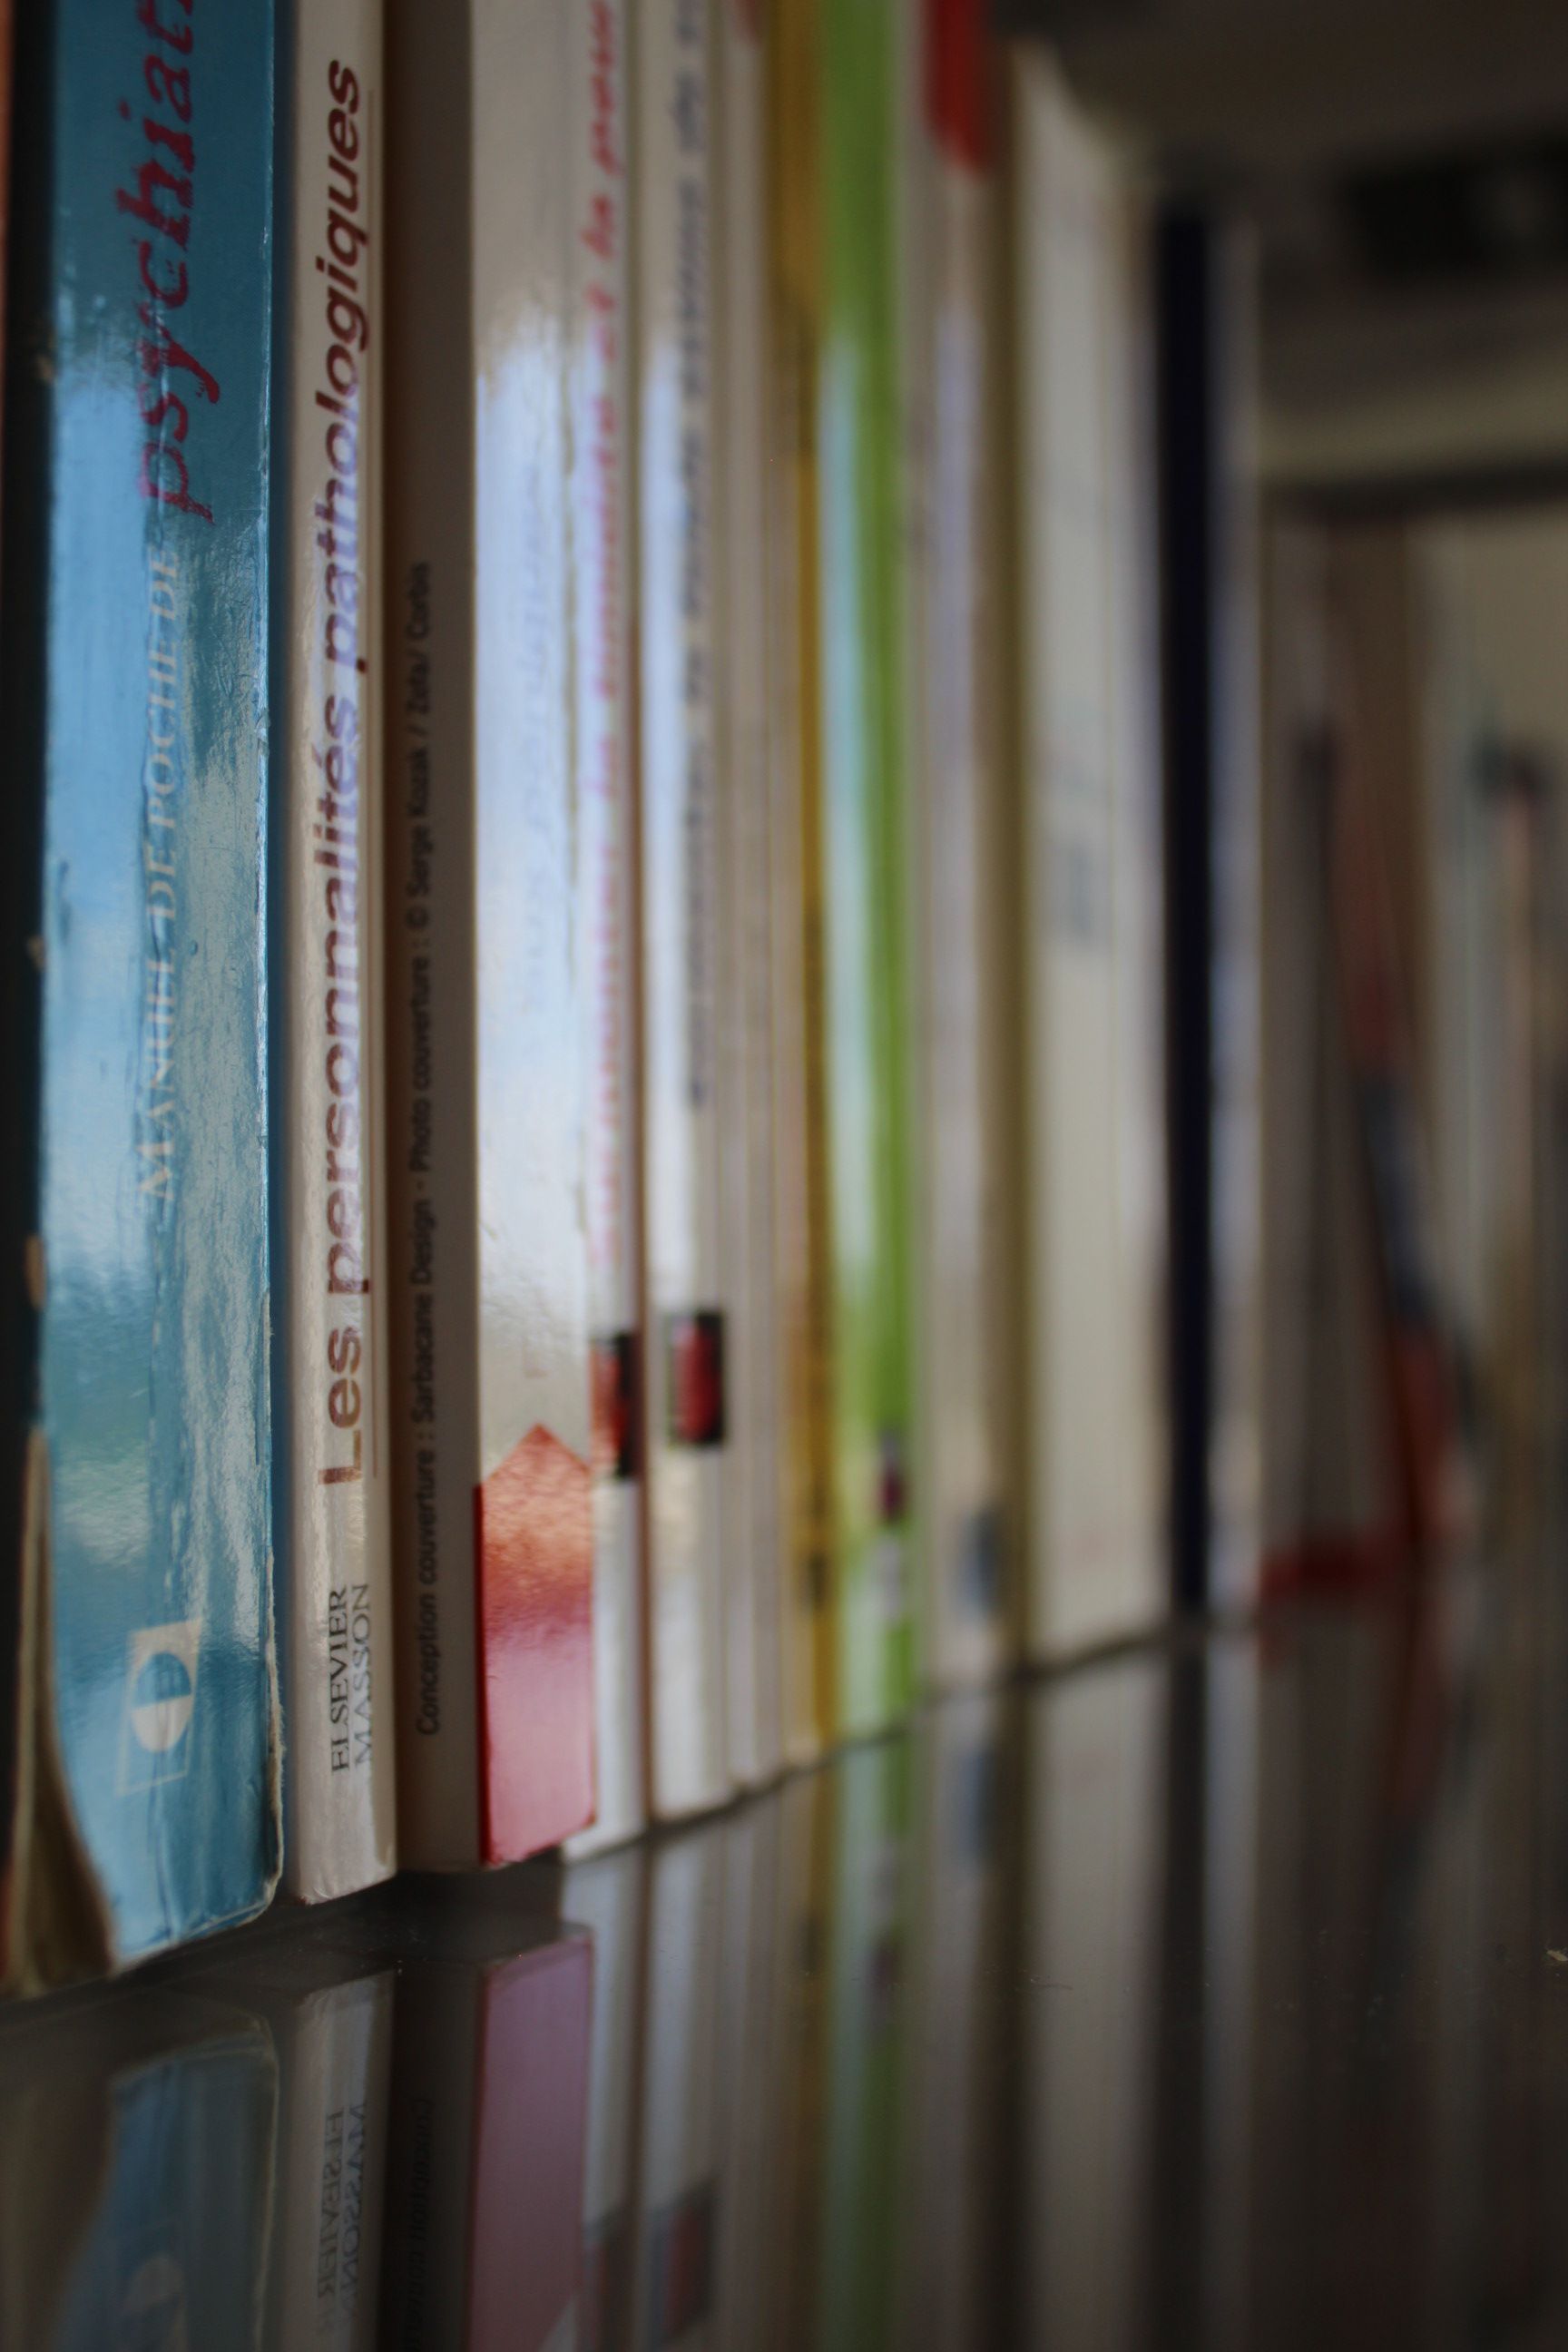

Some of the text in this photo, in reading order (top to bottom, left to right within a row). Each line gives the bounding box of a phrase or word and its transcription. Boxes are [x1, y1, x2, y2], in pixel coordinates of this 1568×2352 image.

[115, 0, 220, 524] psychiat
[148, 544, 179, 621] DE
[144, 632, 178, 829] POCHE
[311, 57, 370, 1485] Les personnalités pathologiques
[142, 838, 177, 920] DE
[406, 824, 434, 898] Serge
[408, 955, 431, 1092] couverture
[408, 1097, 431, 1172] Photo
[408, 1199, 437, 1286] Design
[409, 1291, 436, 1426] Sarbacane
[413, 1448, 437, 1586] couverture
[328, 1585, 351, 1773] ELSEVIER
[351, 1583, 374, 1768] MASSON
[415, 1592, 441, 1736] Conception
